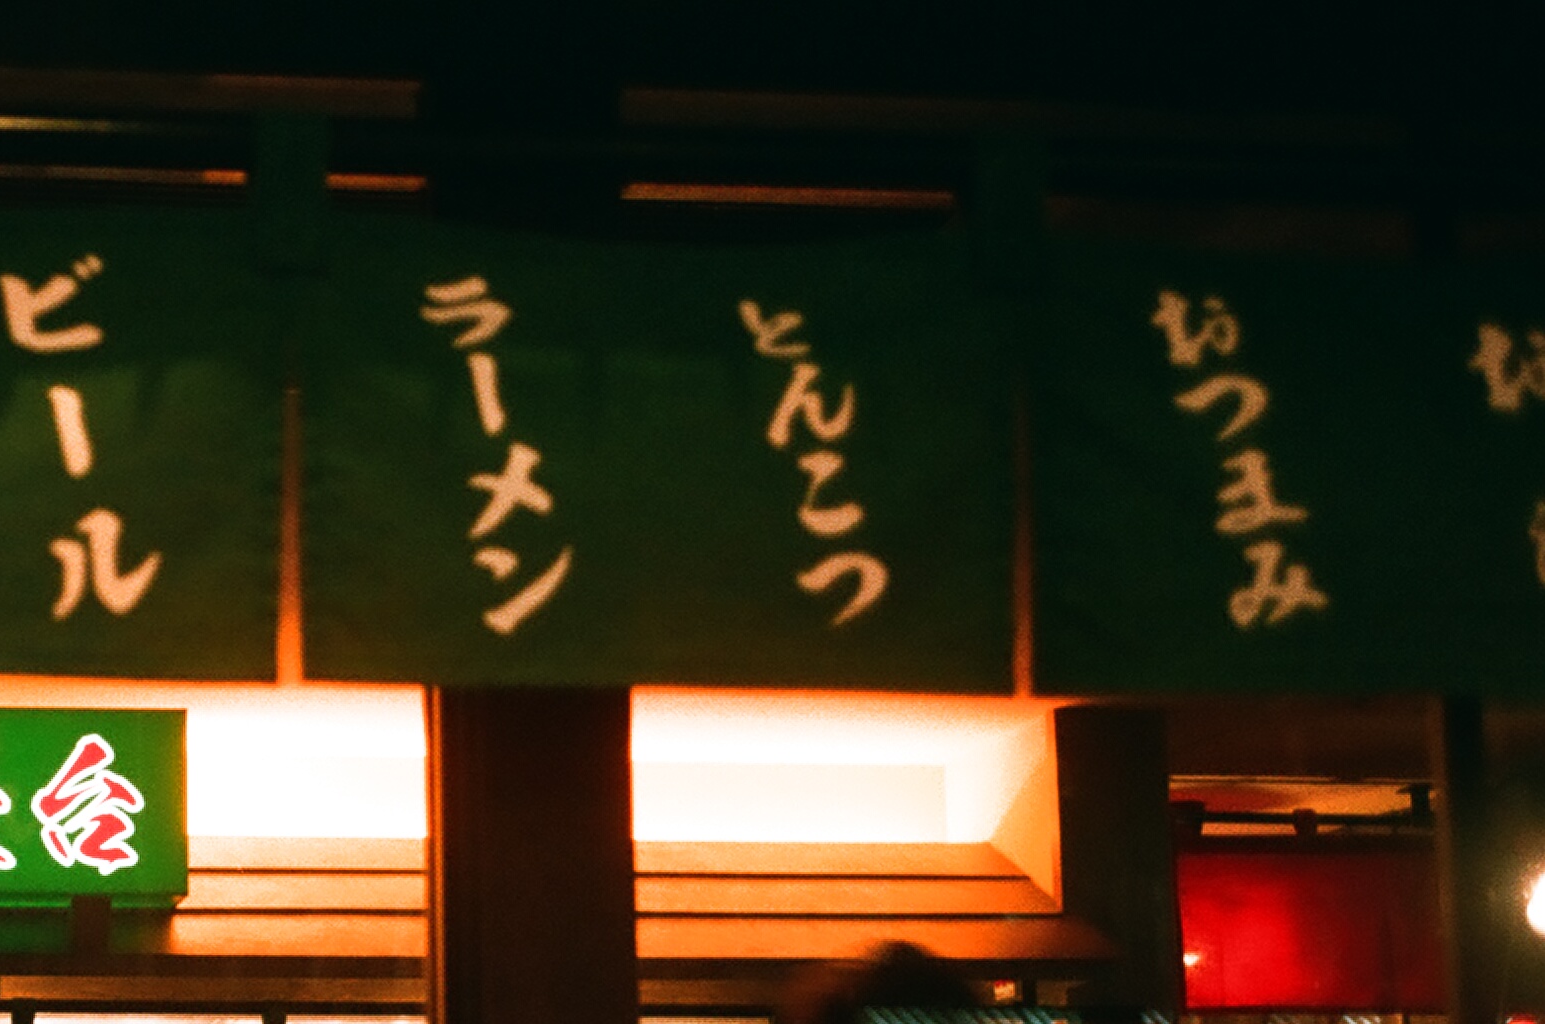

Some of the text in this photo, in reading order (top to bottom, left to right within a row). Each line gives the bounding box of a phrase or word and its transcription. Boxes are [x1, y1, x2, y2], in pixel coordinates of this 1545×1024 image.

[421, 276, 573, 636] ラーメン
[739, 300, 890, 627] とんこつ
[1151, 290, 1330, 629] おつまみ
